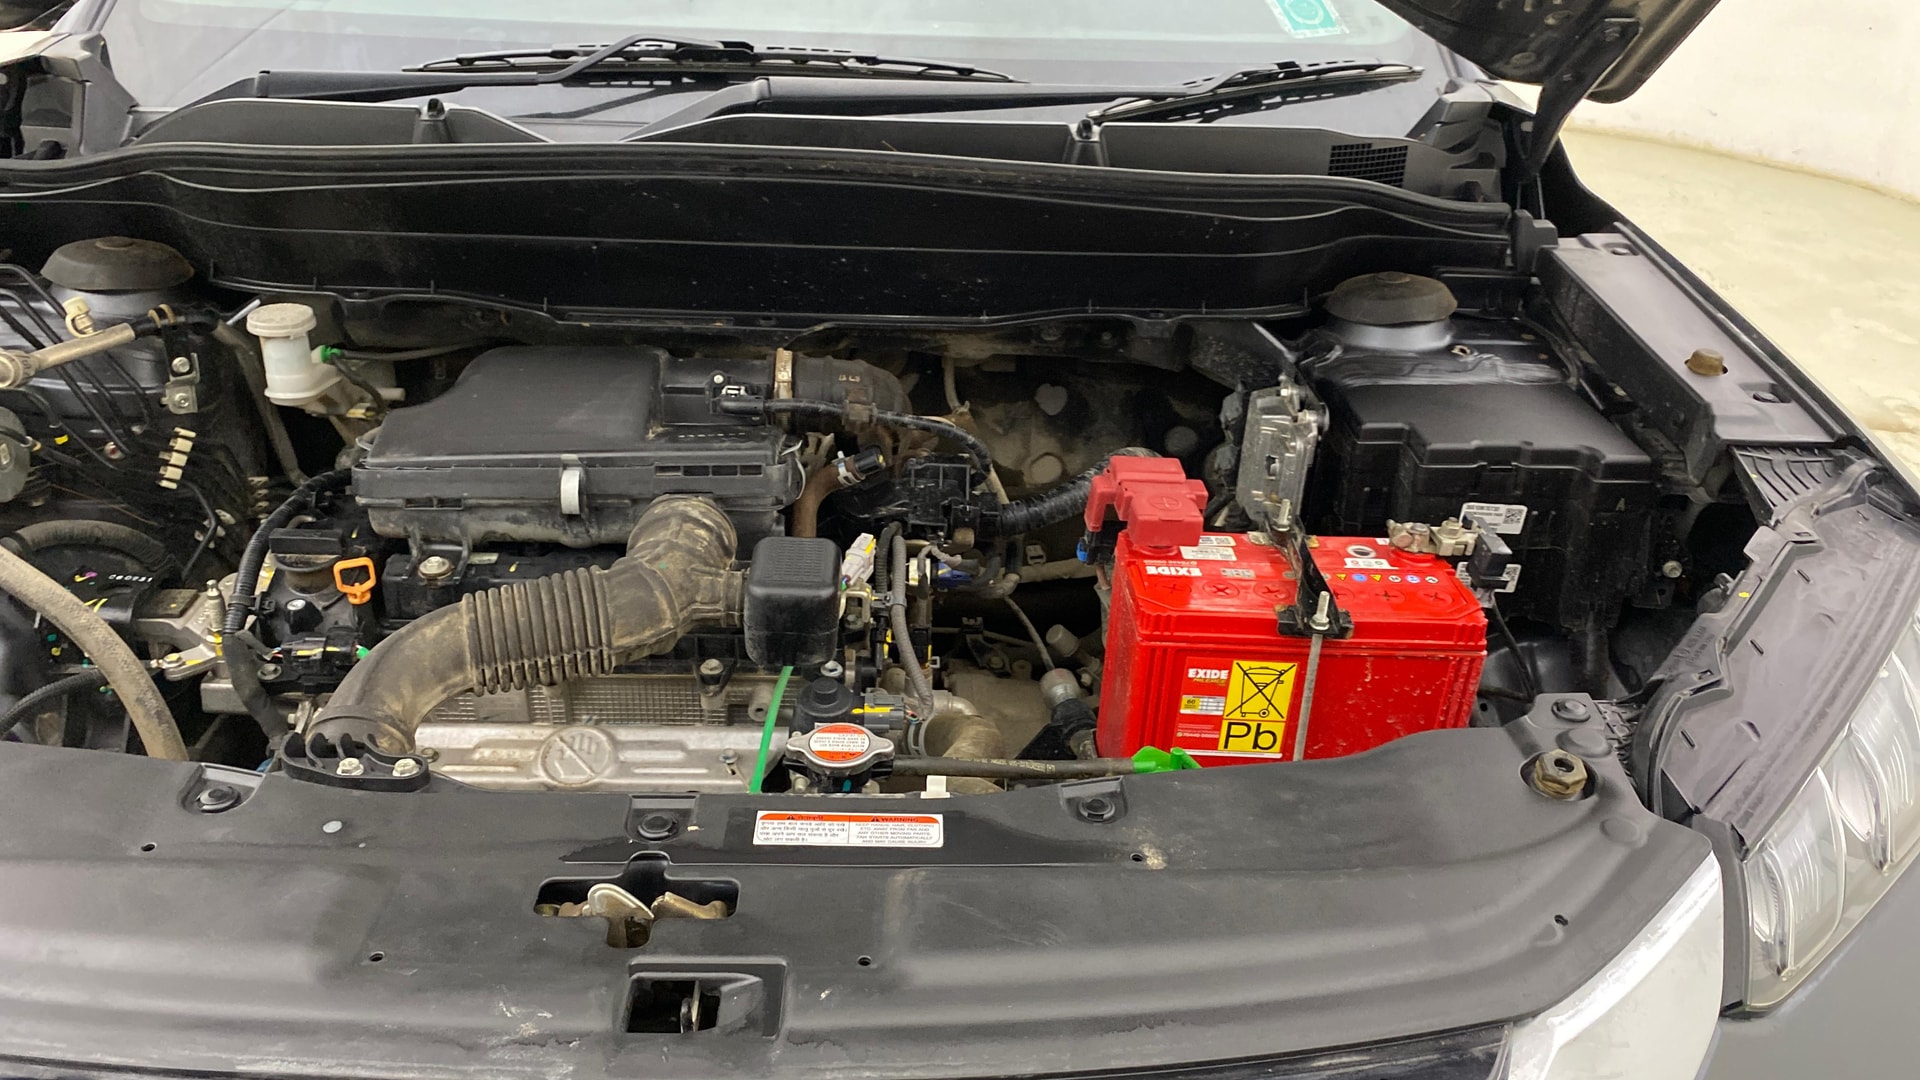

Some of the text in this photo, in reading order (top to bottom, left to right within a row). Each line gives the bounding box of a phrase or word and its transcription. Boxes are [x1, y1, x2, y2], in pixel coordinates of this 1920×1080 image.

[1145, 565, 1203, 577] EXIDE
[1187, 668, 1230, 680] EXIDE
[1223, 721, 1277, 751] Pb
